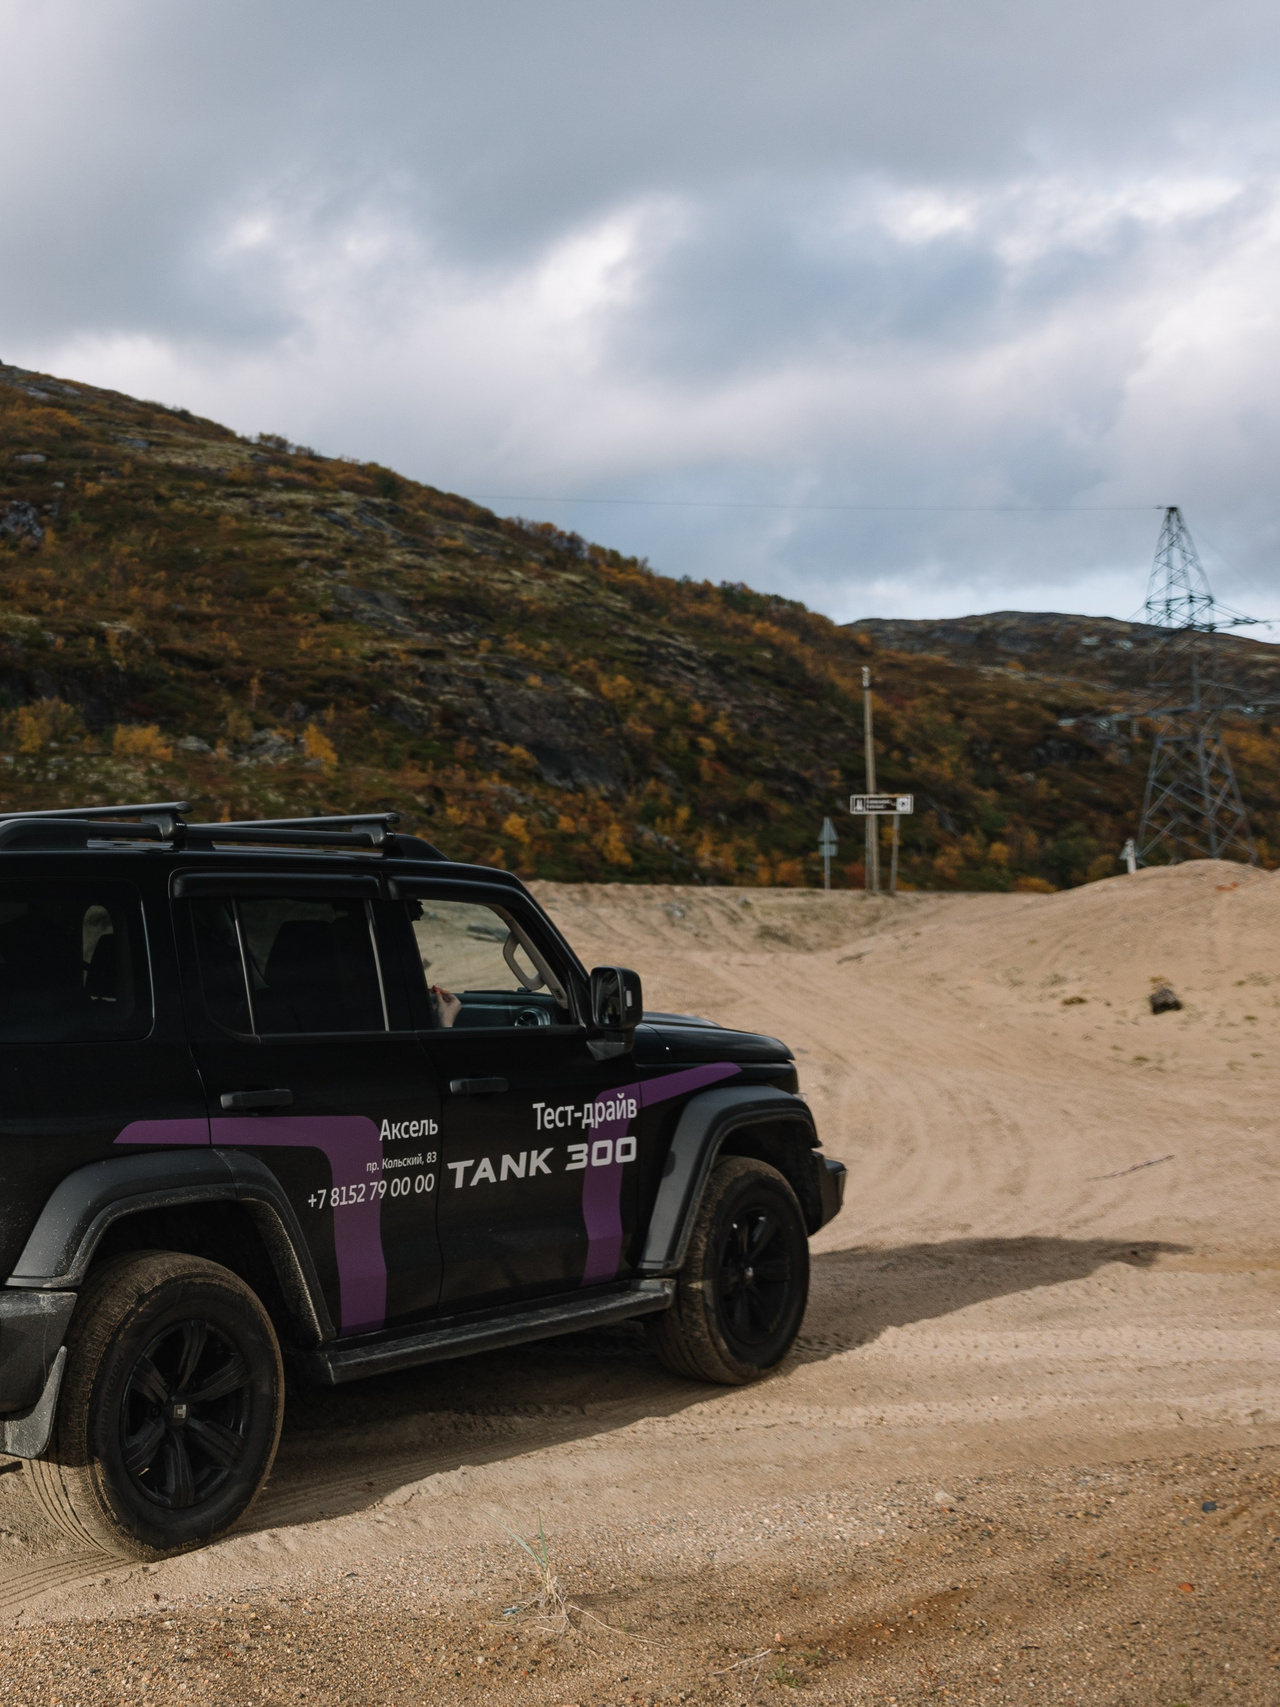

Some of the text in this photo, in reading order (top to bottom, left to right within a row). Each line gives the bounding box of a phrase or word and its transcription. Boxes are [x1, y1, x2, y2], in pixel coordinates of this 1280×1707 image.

[379, 1118, 439, 1142] Аксель
[532, 1093, 638, 1131] Тест-драйв
[366, 1151, 437, 1174] пр. Кольский, 83
[447, 1136, 637, 1189] TANK 300
[307, 1173, 435, 1210] +7 8152 79 00 00
